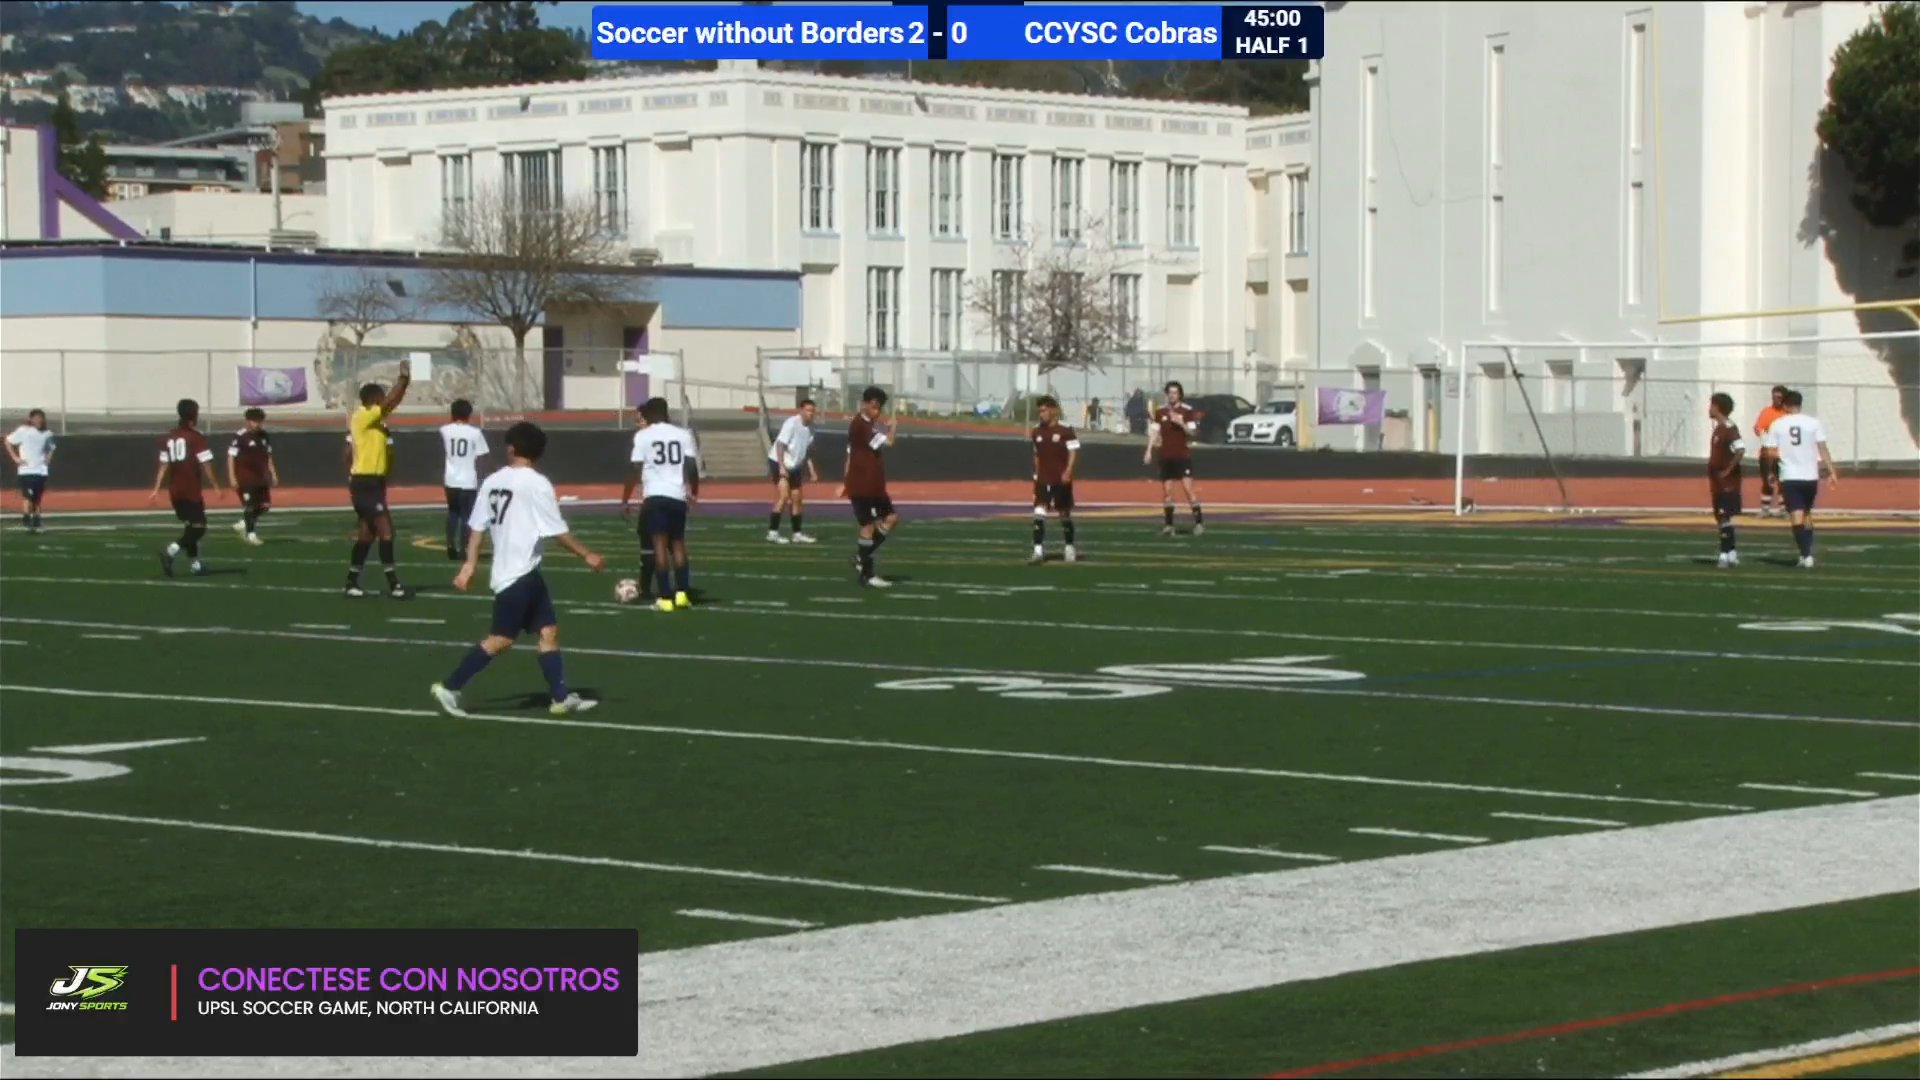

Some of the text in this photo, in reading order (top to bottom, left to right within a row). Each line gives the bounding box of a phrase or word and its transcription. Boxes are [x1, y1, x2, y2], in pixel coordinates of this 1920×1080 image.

[1789, 426, 1802, 446] 9
[166, 437, 187, 462] 10
[450, 438, 468, 457] 10
[651, 440, 682, 465] 30
